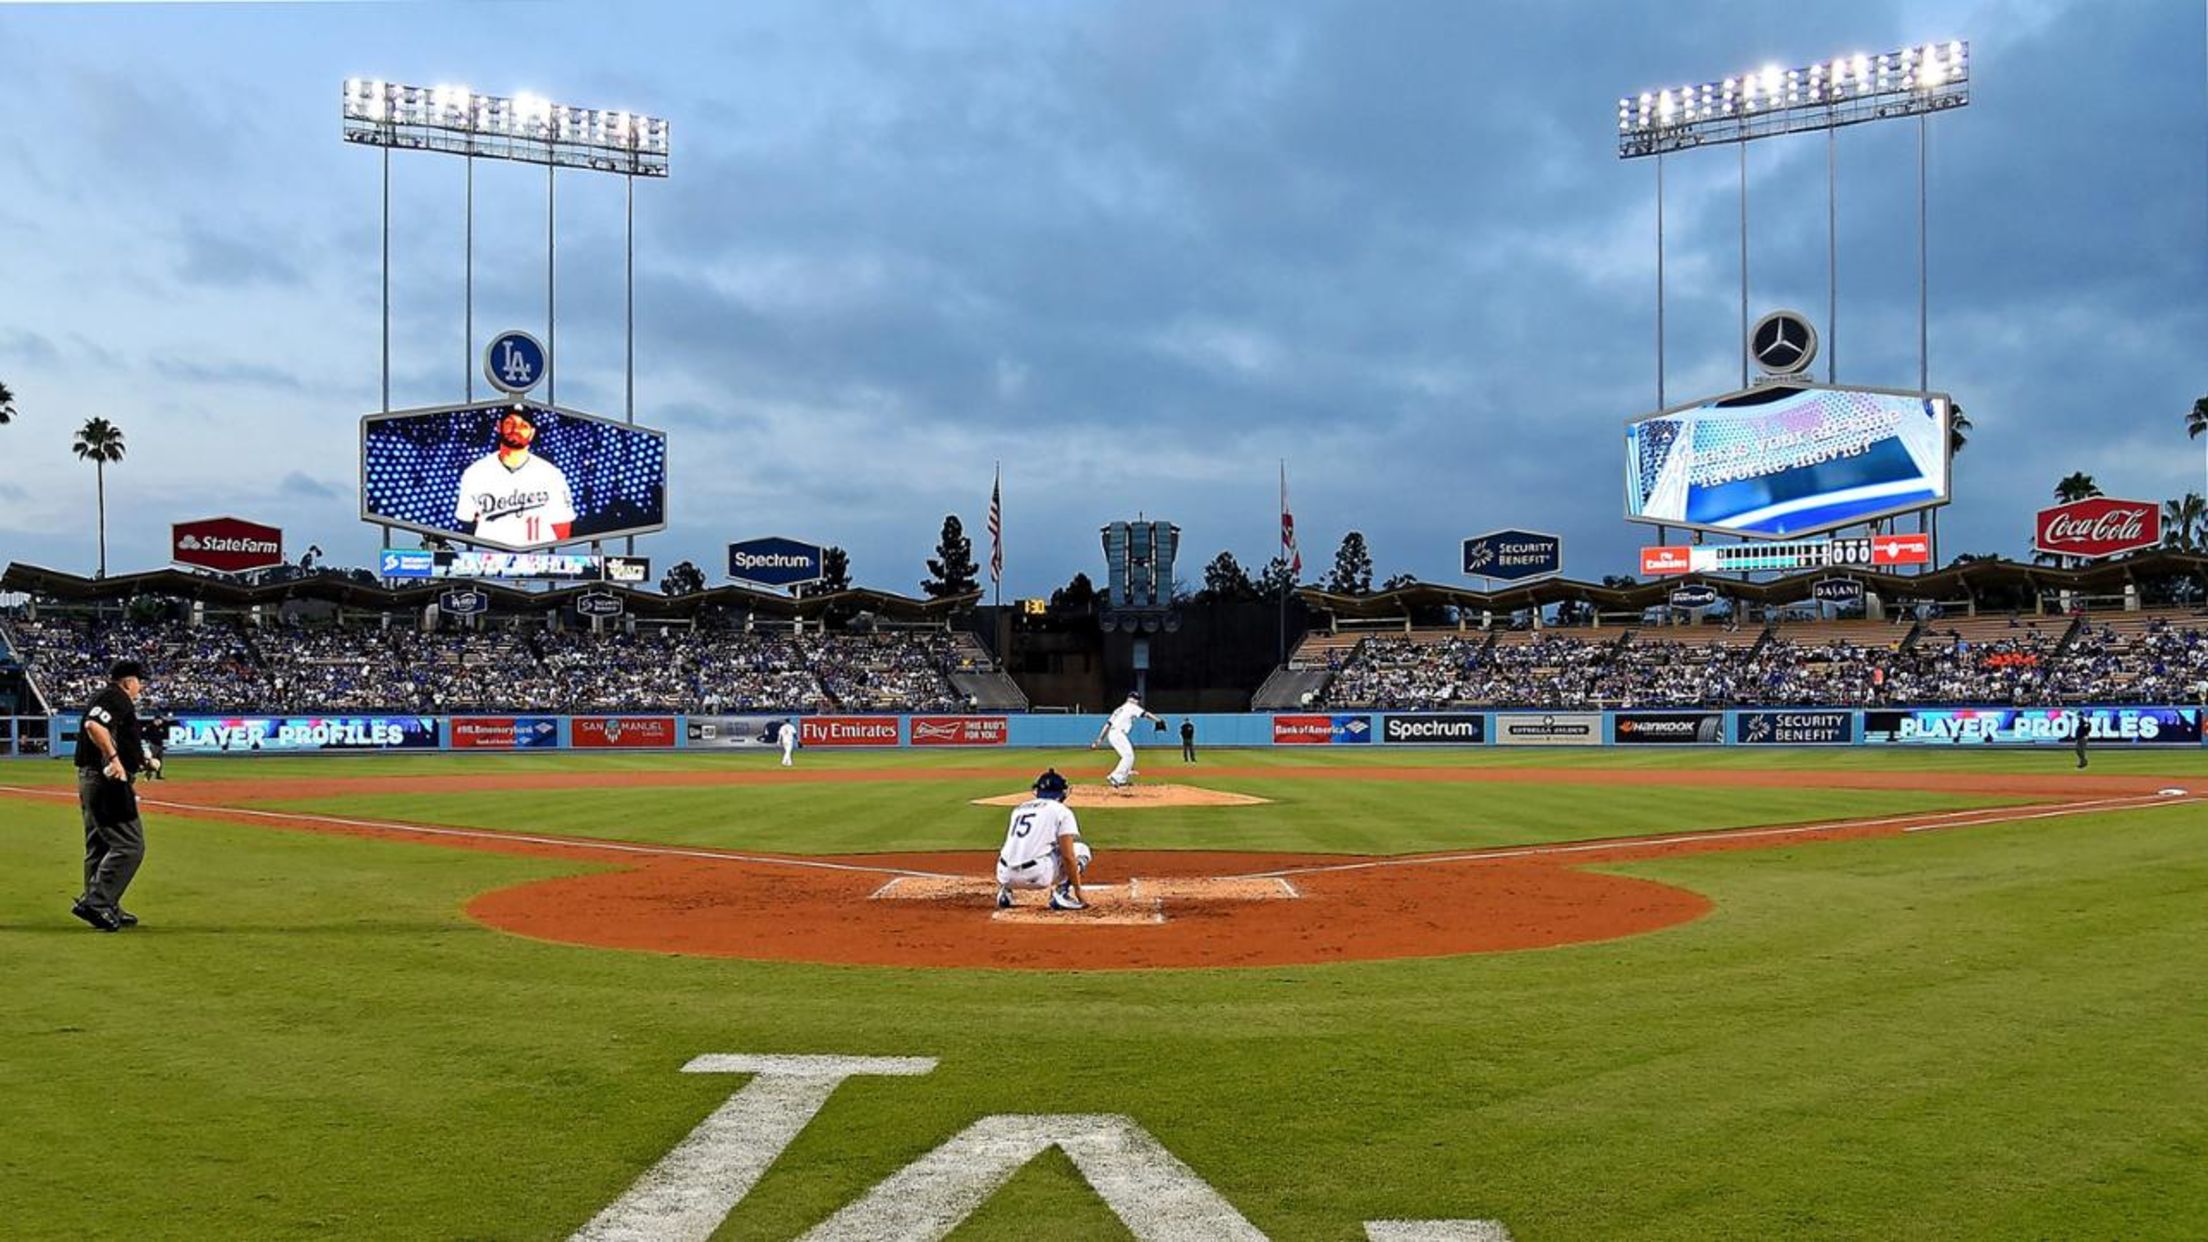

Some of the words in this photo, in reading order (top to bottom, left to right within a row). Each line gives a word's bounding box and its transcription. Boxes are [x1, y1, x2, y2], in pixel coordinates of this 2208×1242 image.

[502, 340, 531, 382] LA
[479, 489, 549, 519] Dodgers
[526, 516, 540, 540] 11
[1499, 543, 1553, 553] SECURITY
[735, 551, 809, 570] Spectrum
[1816, 584, 1858, 597] DASANI
[582, 722, 604, 731] SAN
[621, 722, 662, 731] MANUEL
[965, 721, 981, 730] THIS
[984, 721, 1005, 730] BUD'S
[1776, 714, 1844, 727] SECURITY
[1900, 718, 1999, 738] PLAYER
[169, 725, 265, 746] PLAYER
[279, 724, 404, 745] PROFILES
[803, 723, 828, 741] Fly
[831, 723, 896, 738] Emirates
[965, 731, 980, 740] FOR
[1389, 720, 1473, 740] Spectrum
[1776, 729, 1834, 741] BENEFIT
[1011, 813, 1036, 838] 15
